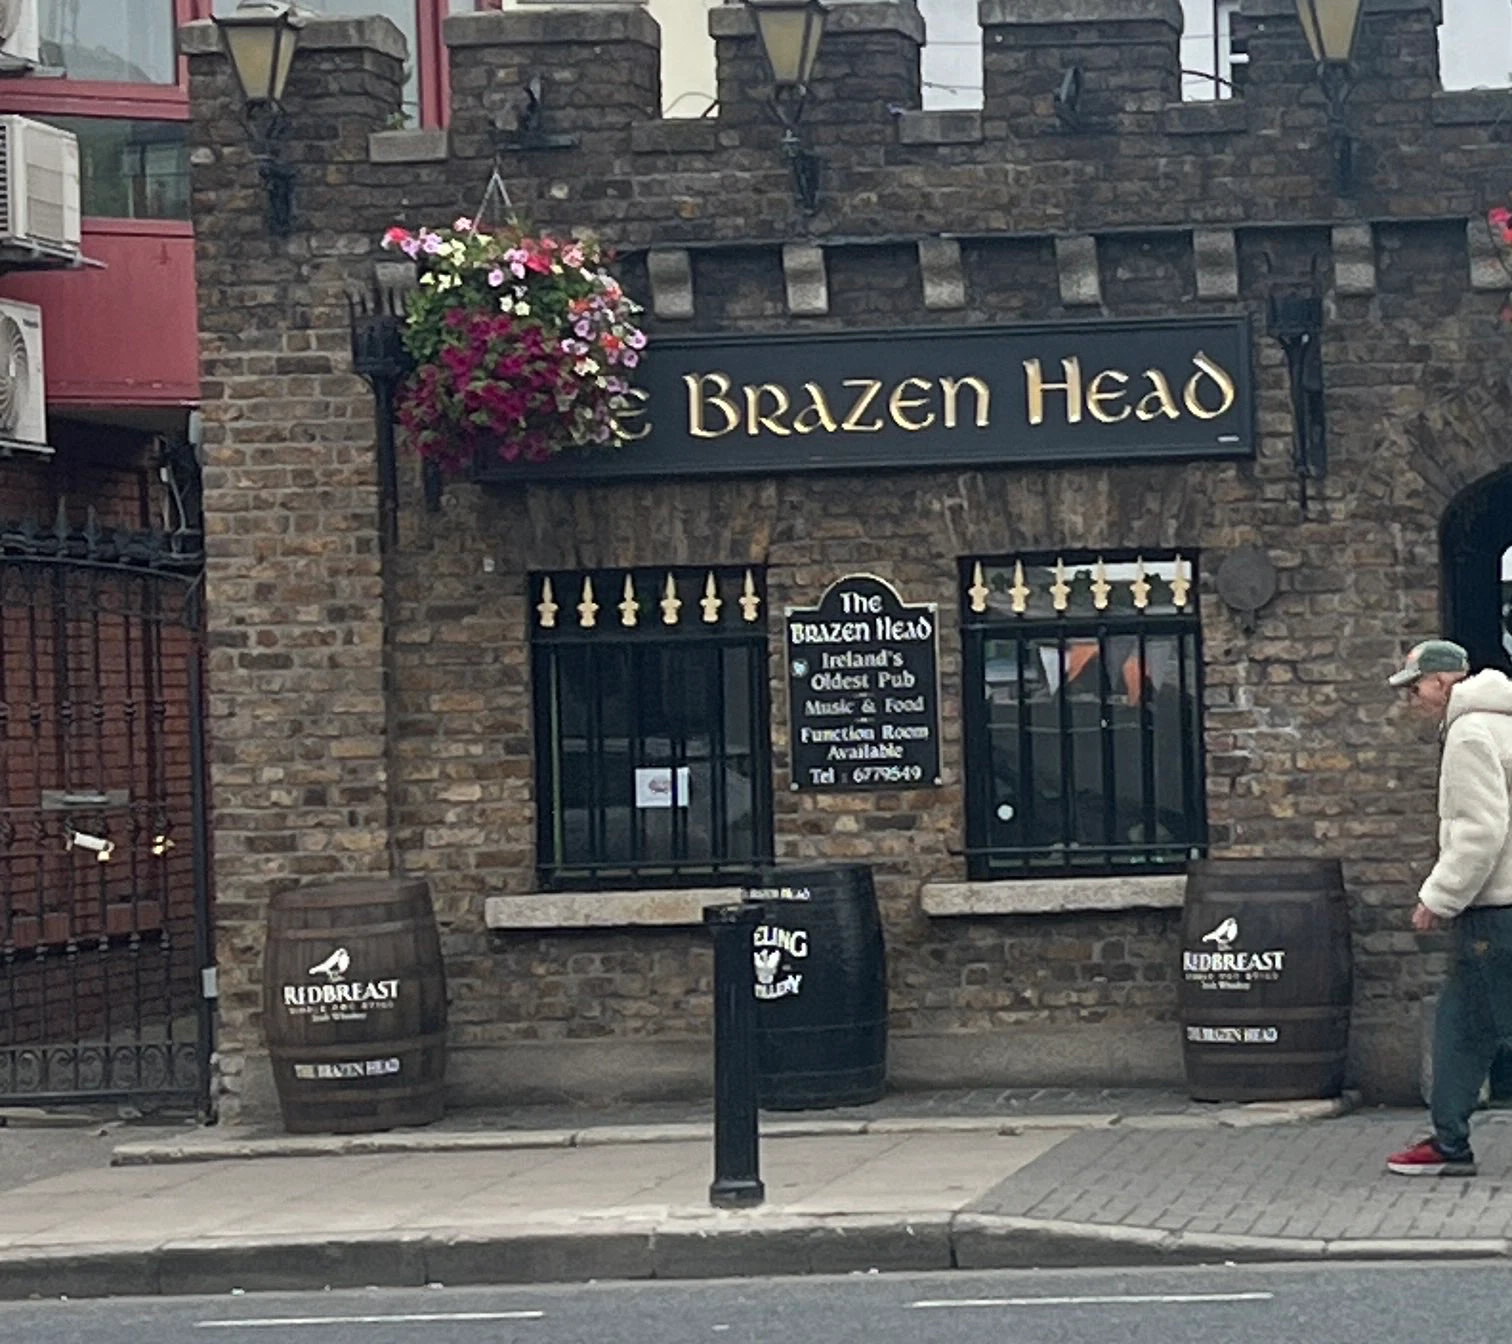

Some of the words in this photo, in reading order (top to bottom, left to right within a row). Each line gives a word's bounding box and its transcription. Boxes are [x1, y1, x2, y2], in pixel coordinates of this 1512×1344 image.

[840, 591, 883, 614] The
[821, 648, 904, 670] Ireland's
[810, 671, 870, 691] Oldest
[877, 670, 916, 689] Pub
[804, 699, 853, 716] Music
[861, 700, 877, 714] &
[885, 696, 925, 713] Food
[800, 725, 875, 744] Function
[881, 724, 929, 741] Room
[827, 742, 904, 761] Available
[753, 925, 808, 958] ELING
